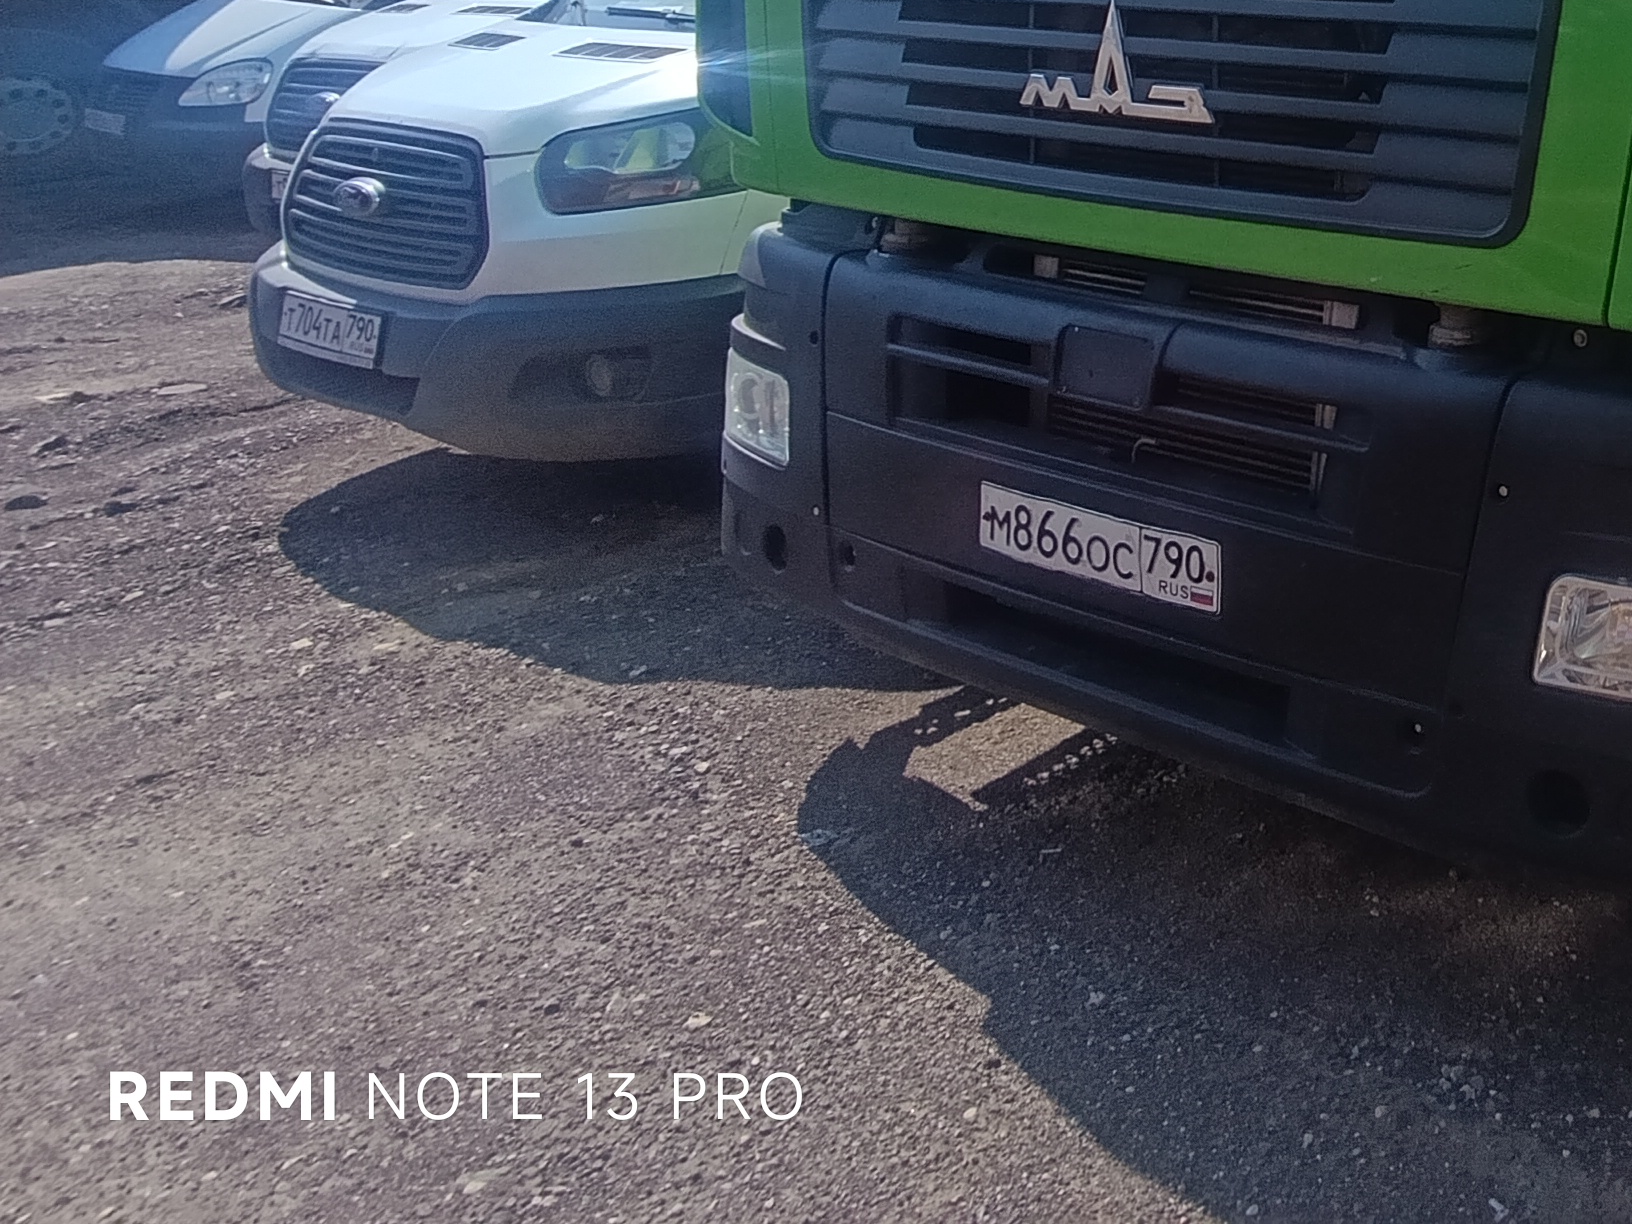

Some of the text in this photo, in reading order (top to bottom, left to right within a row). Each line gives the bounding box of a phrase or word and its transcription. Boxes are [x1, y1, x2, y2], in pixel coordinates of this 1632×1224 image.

[347, 314, 375, 342] 790
[990, 504, 1206, 584] М866ОС 790
[1158, 580, 1190, 599] RUS
